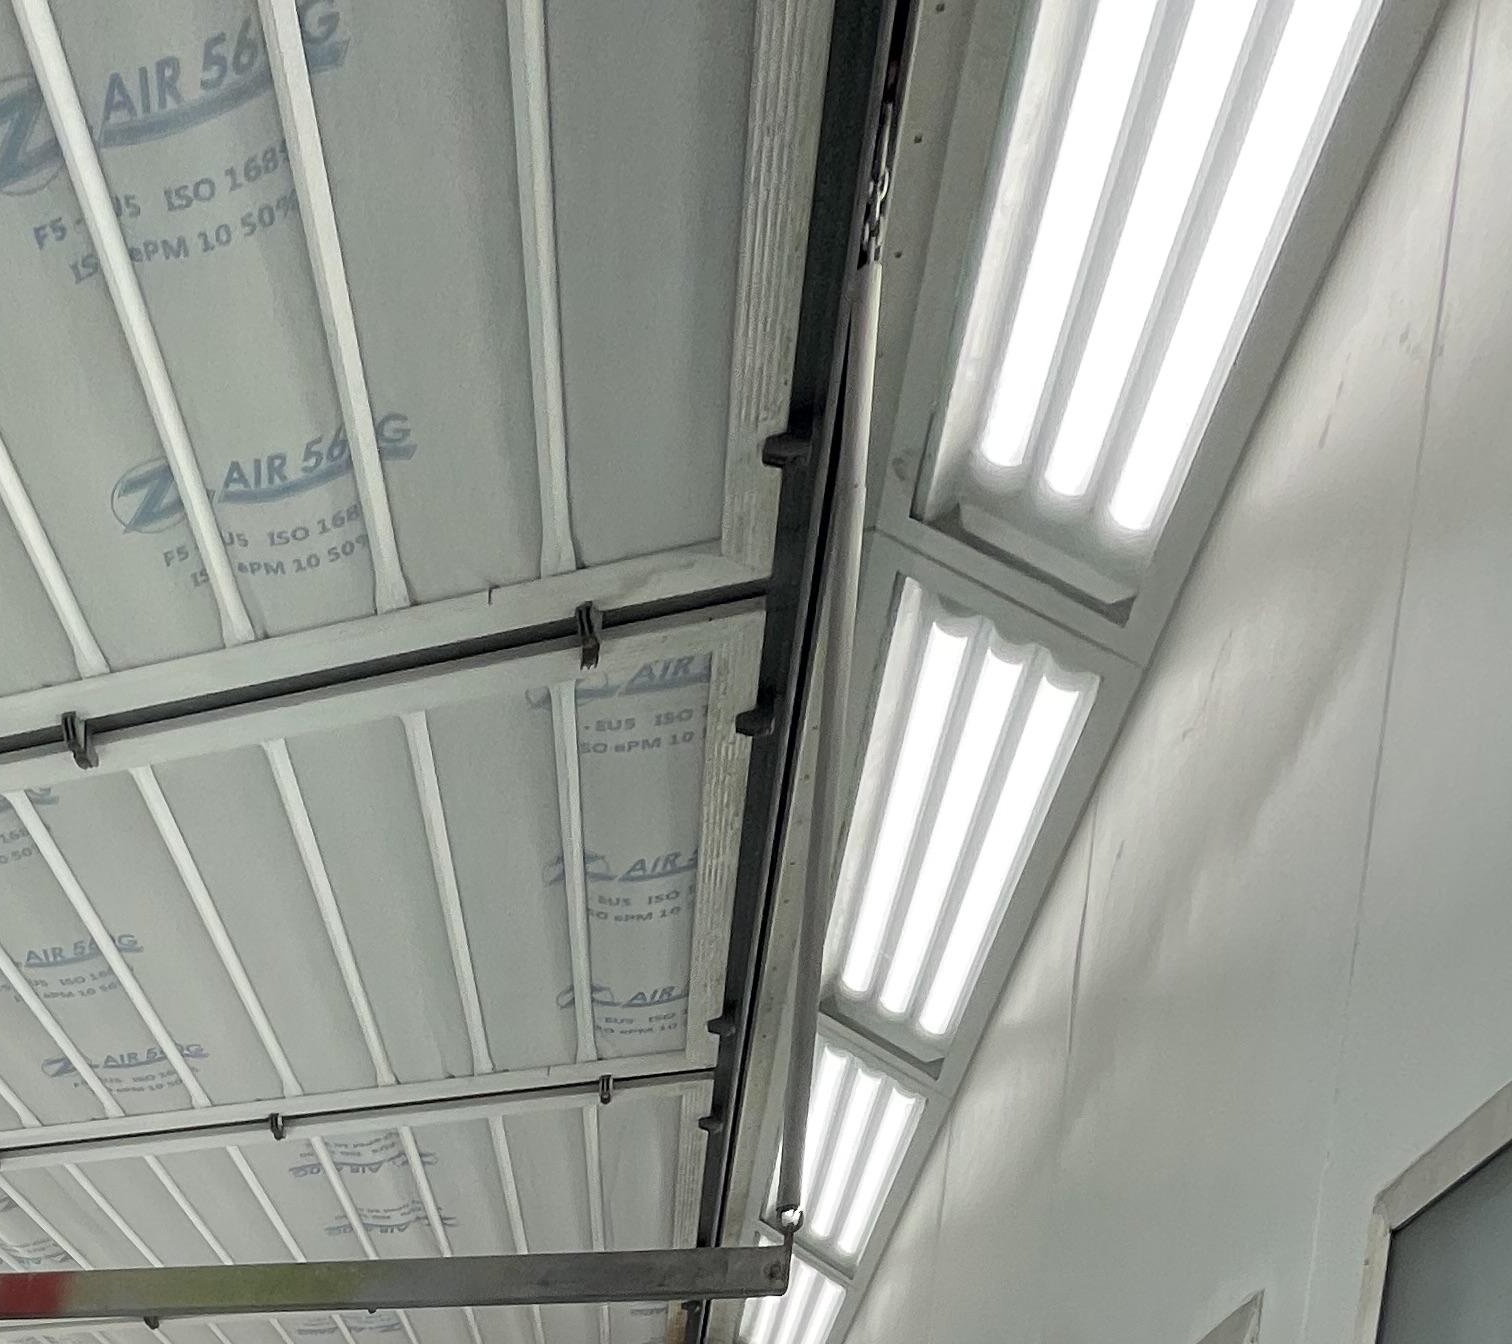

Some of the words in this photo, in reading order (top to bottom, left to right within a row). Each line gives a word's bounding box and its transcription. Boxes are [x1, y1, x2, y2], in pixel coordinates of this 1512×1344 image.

[102, 55, 185, 121] AIR
[33, 217, 67, 250] F5
[163, 178, 216, 212] ISO
[69, 254, 99, 284] IS
[198, 223, 232, 252] 10
[223, 452, 288, 489] AIR
[163, 546, 188, 567] F5
[267, 526, 310, 547] ISO
[191, 569, 210, 587] IS
[292, 554, 320, 573] 10
[626, 655, 695, 690] AIR
[654, 708, 694, 727] ISO
[669, 731, 695, 746] 10
[625, 851, 682, 876] AIR
[648, 890, 680, 905] ISO
[26, 946, 64, 963] AIR
[628, 986, 676, 1003] AIR
[104, 1051, 138, 1066] AIR
